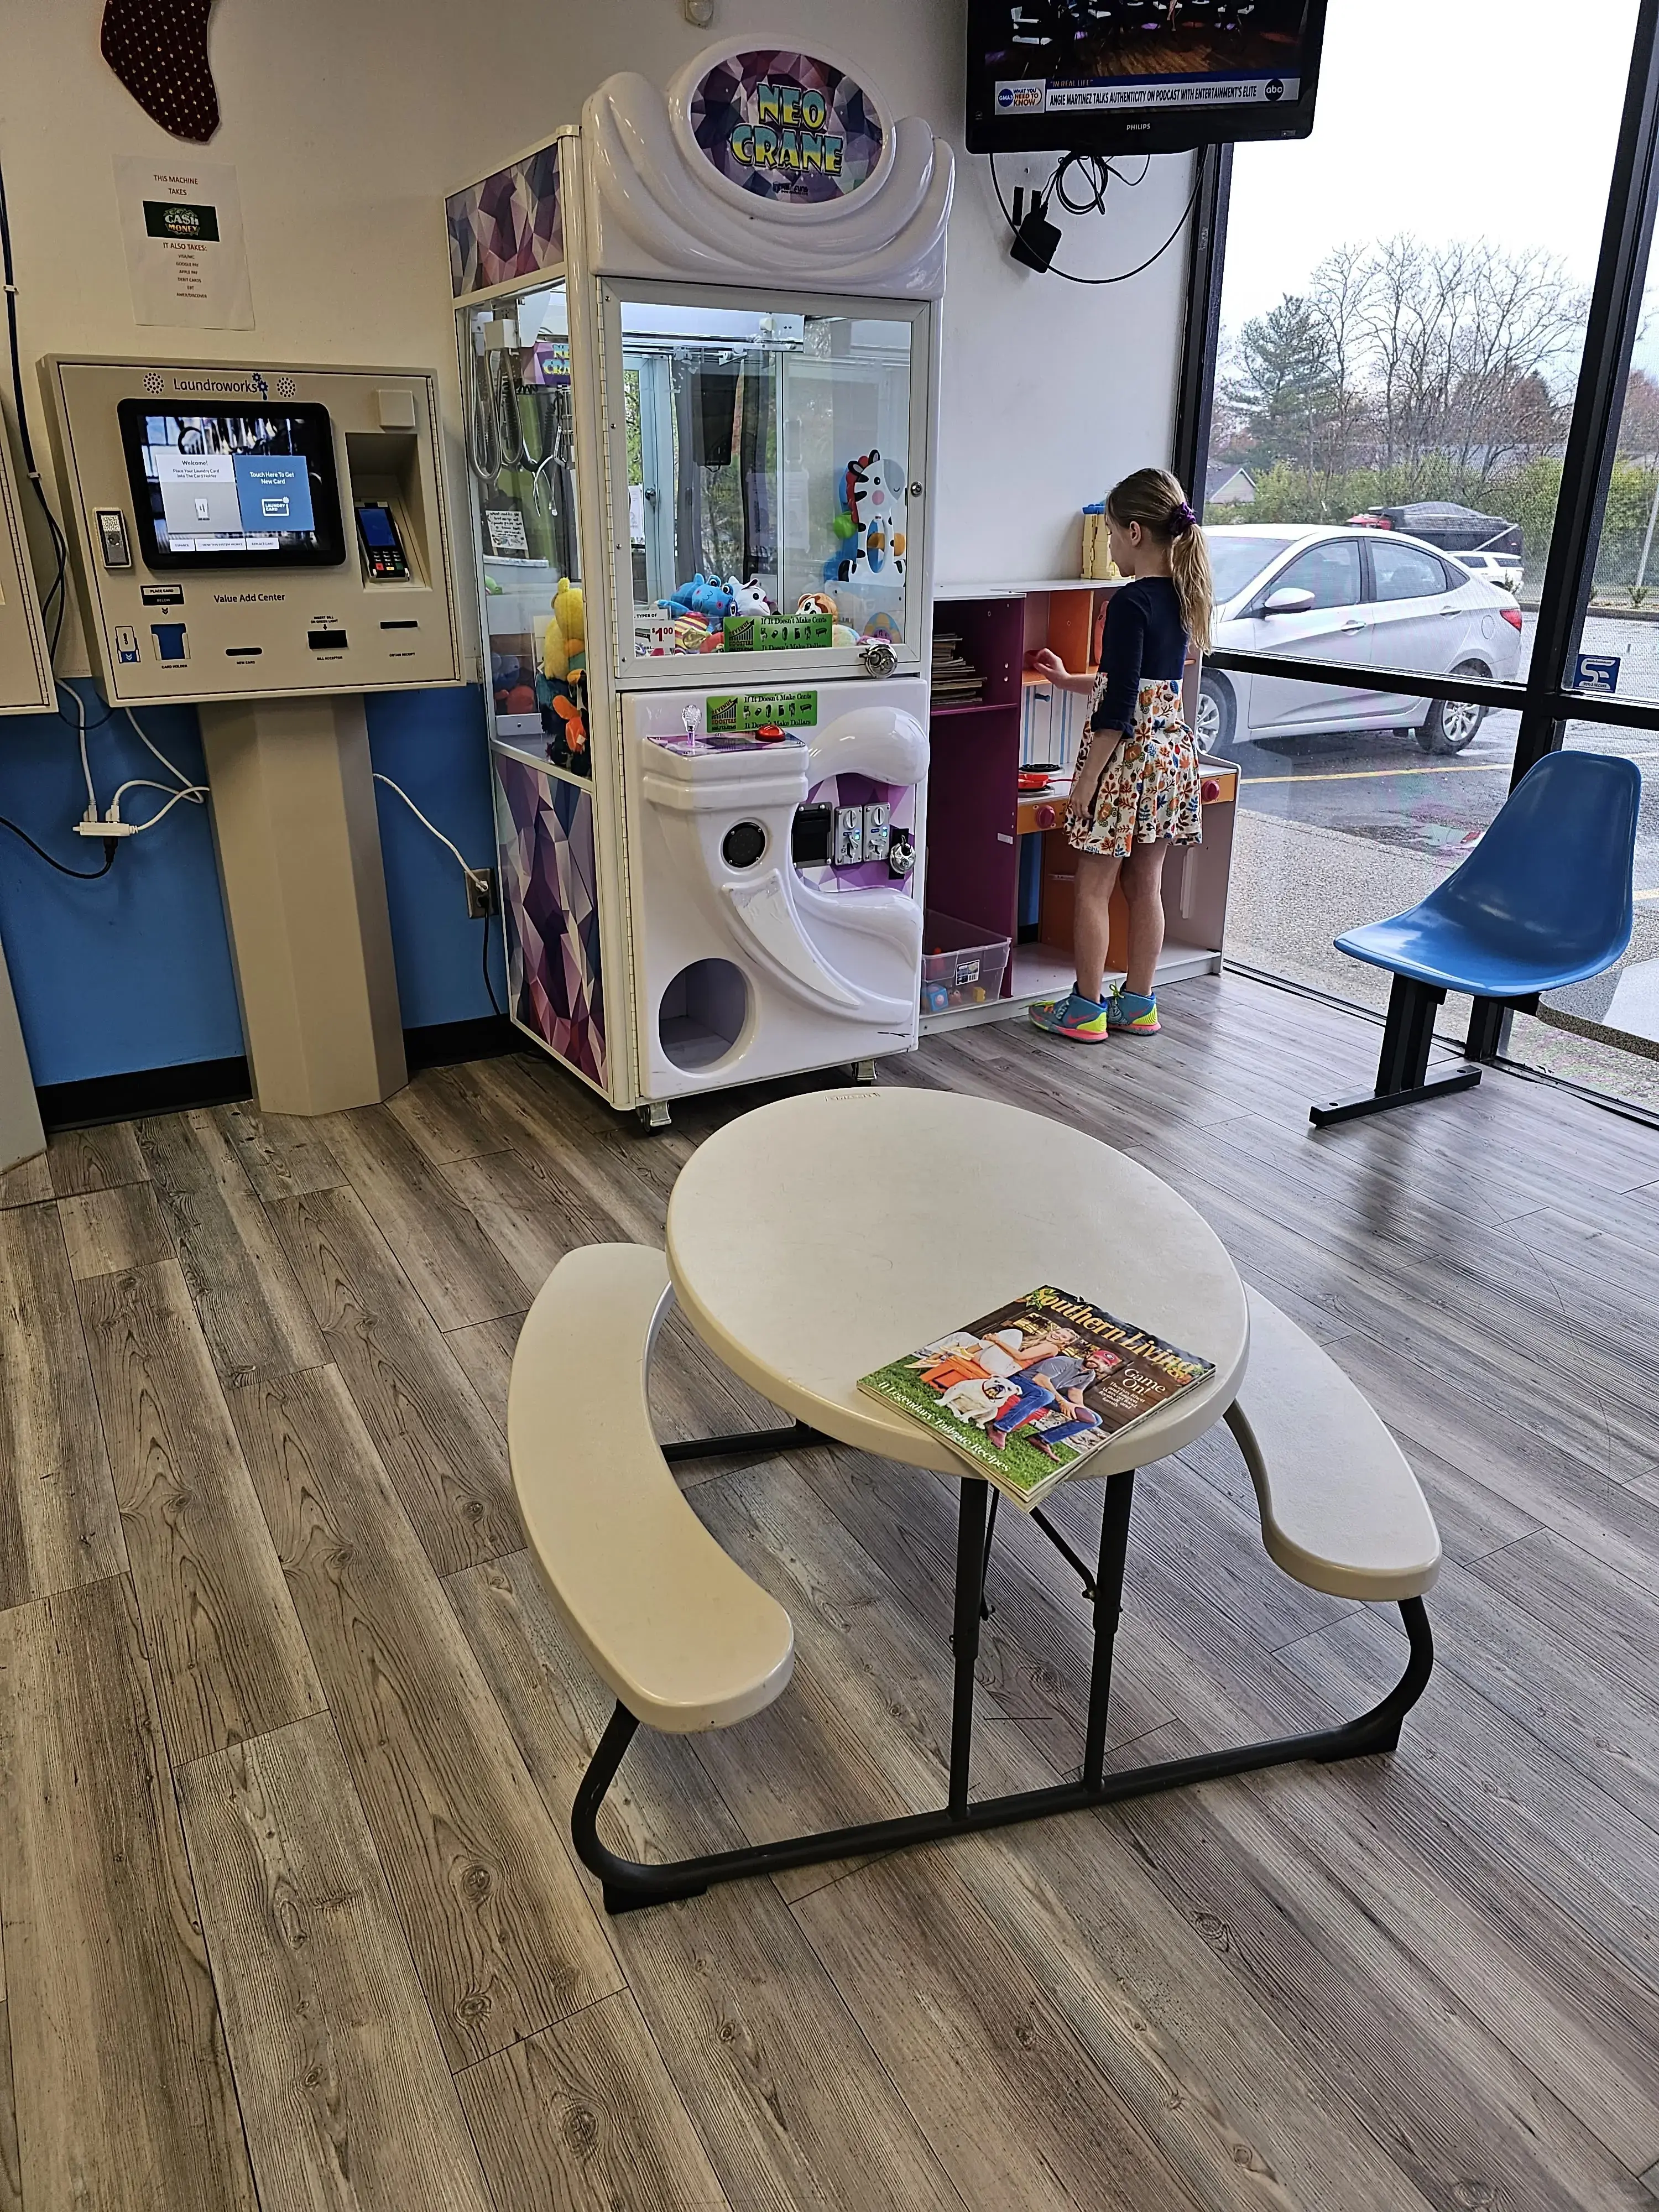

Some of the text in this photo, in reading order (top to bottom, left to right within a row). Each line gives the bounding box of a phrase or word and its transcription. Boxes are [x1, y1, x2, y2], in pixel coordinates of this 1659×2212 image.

[1050, 85, 1257, 106] ANGIE MARTINEZ TALKS AUTHENTICITY ON PODCAST WITH ENTERTAINMENT'S ELITE
[758, 83, 826, 131] NEO
[731, 123, 843, 176] CRANE
[169, 176, 199, 185] MACHINE
[164, 214, 199, 226] CASH
[168, 223, 197, 232] MONEY
[173, 378, 258, 393] Laundroworks
[213, 593, 285, 603] Value Add Center
[729, 620, 749, 635] REVENUE
[774, 616, 795, 624] Doesn't
[796, 615, 812, 623] Make
[759, 693, 779, 702] Doesn't
[712, 698, 733, 715] REVENUE
[1030, 1287, 1196, 1379] Southern Living
[1122, 1378, 1151, 1396] On!
[1124, 1368, 1166, 1394] Game
[886, 1386, 932, 1420] Legendary
[935, 1417, 972, 1444] Tailgate
[971, 1443, 1010, 1472] Recipes
